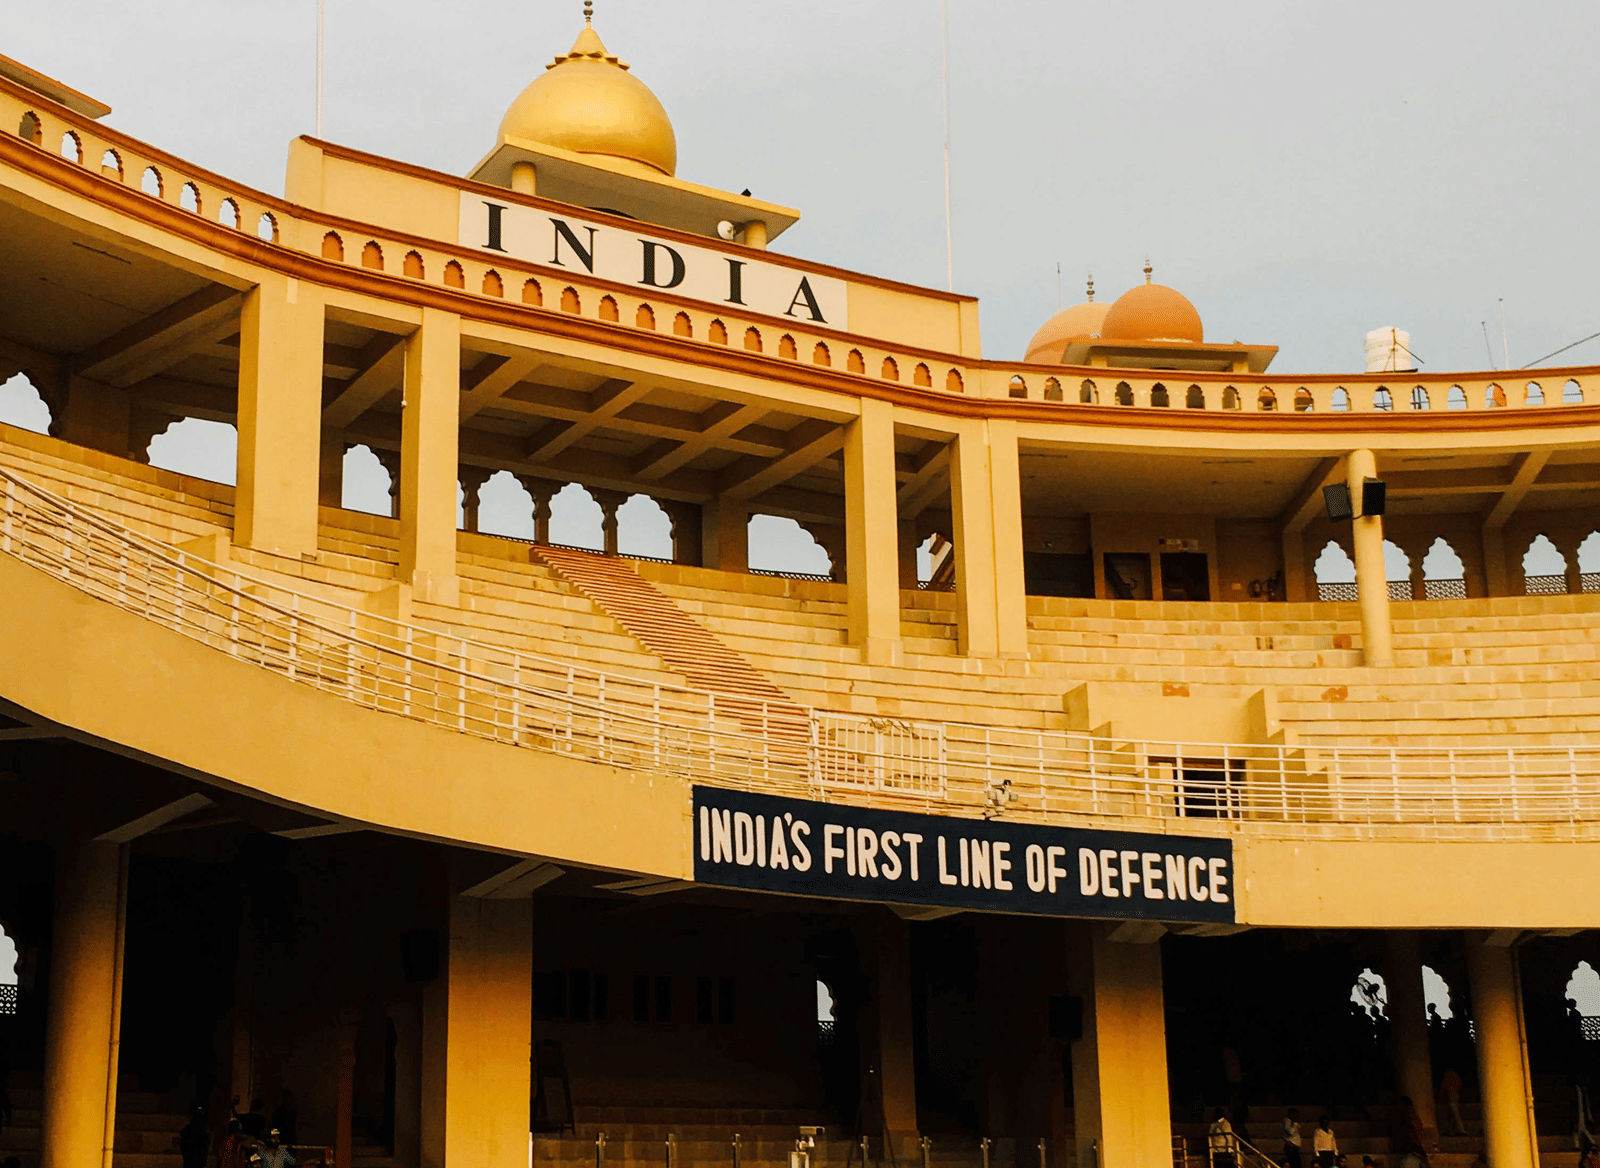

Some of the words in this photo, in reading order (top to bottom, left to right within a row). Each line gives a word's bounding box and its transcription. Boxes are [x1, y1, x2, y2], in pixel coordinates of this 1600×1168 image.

[481, 201, 828, 324] INDIA
[699, 805, 812, 872] INDIA'S
[823, 823, 924, 882] FIRST
[937, 835, 1013, 891] LINE
[1025, 844, 1067, 894] OF
[1078, 847, 1229, 903] DEFENCE
